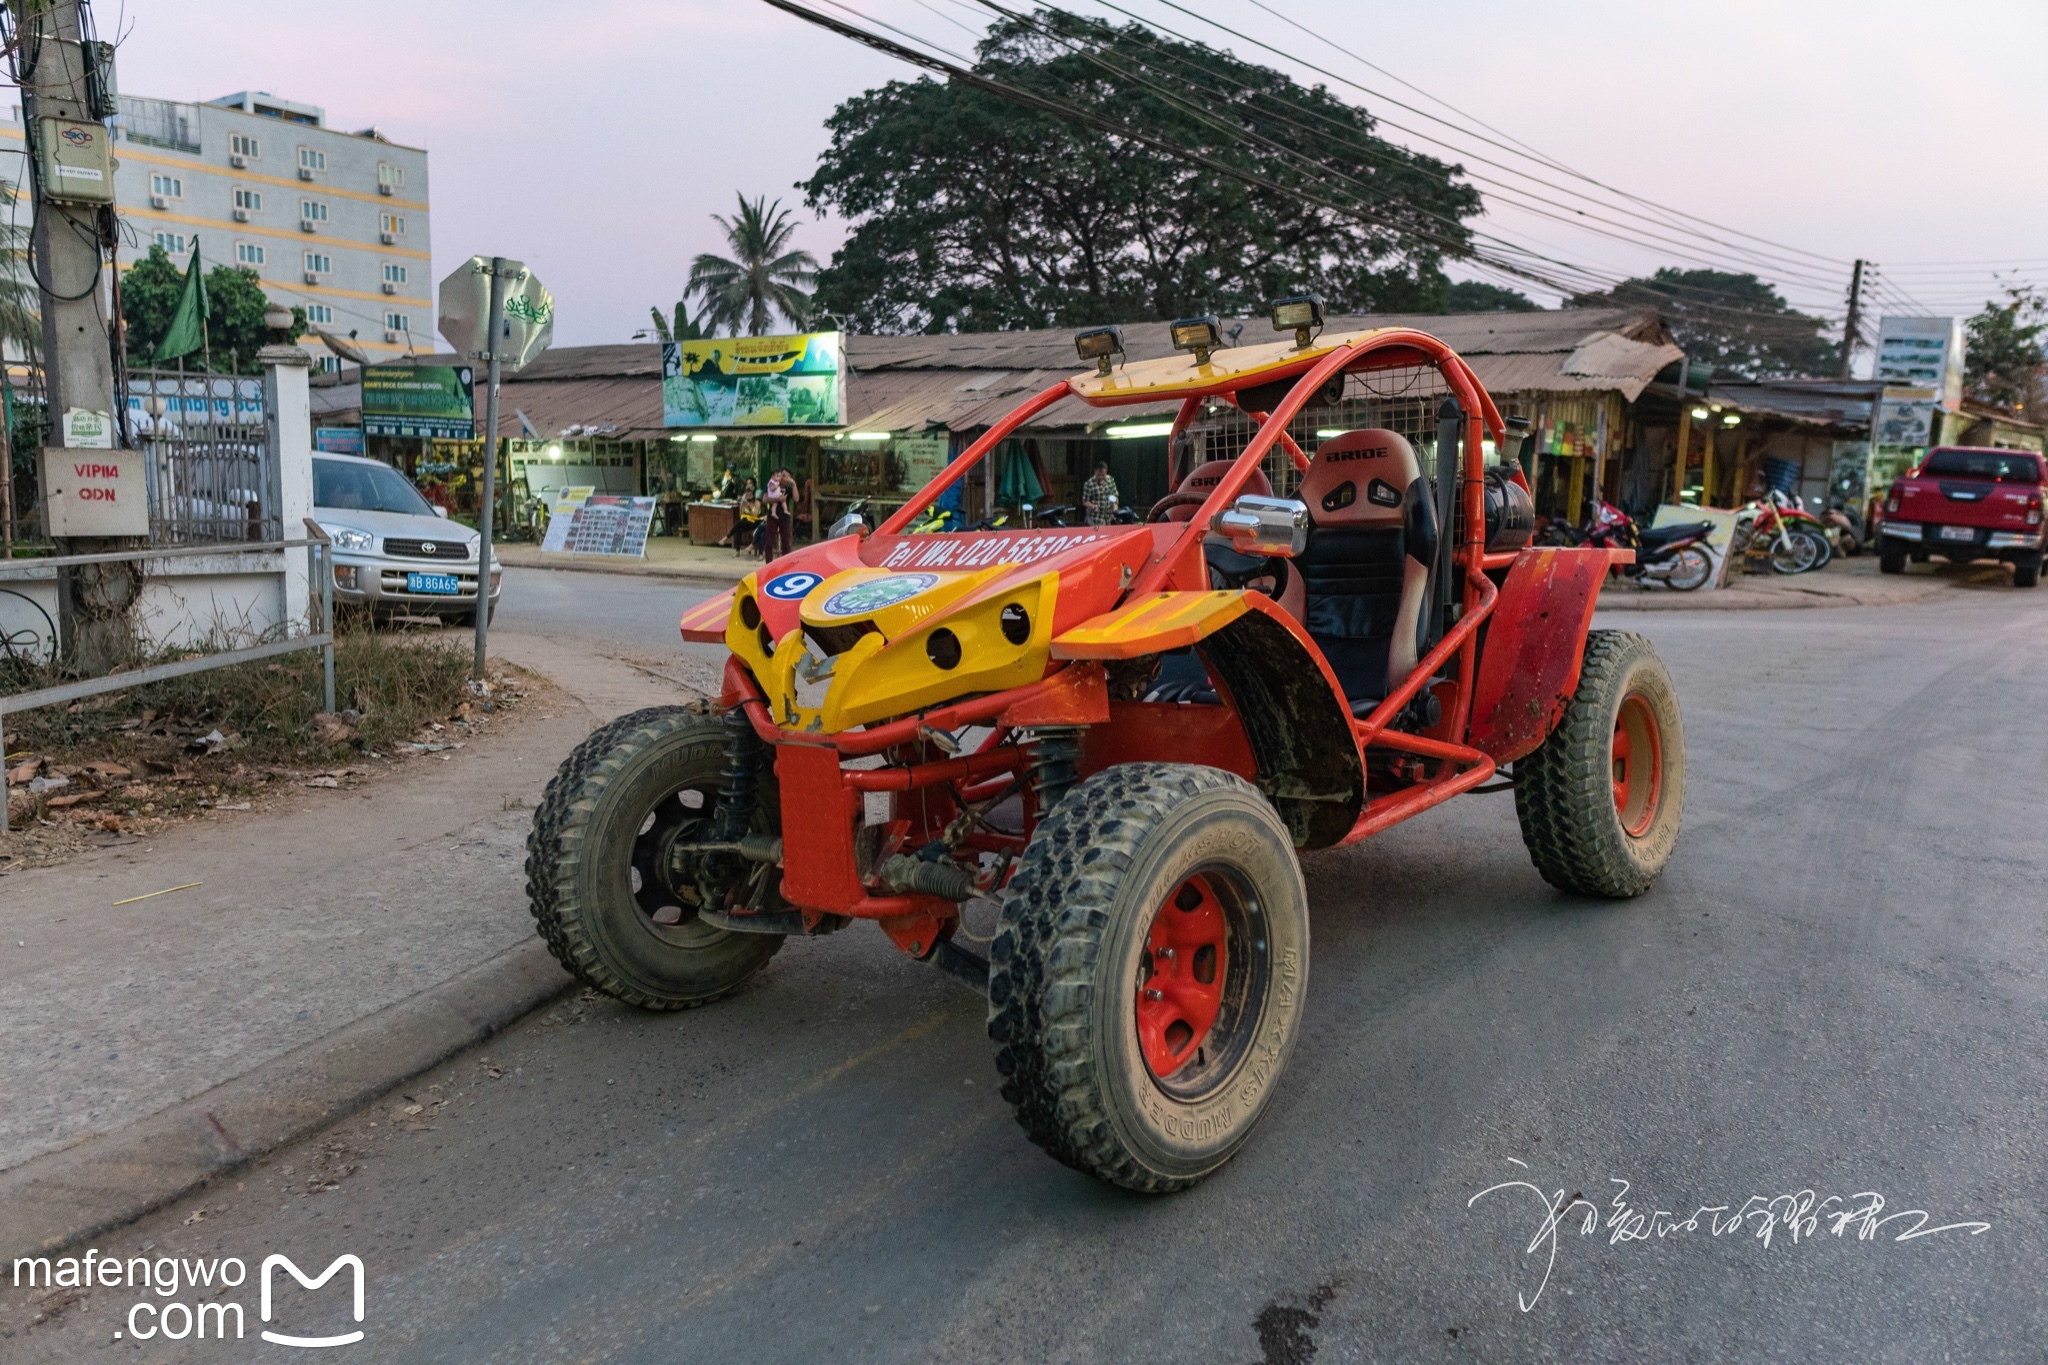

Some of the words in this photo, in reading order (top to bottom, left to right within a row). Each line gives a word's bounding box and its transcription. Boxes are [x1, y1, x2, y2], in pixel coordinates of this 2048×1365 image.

[397, 382, 421, 390] CLIMBING
[164, 393, 229, 417] limbing
[1326, 447, 1388, 463] BRIDE
[1190, 476, 1223, 487] BRI
[79, 487, 115, 501] ODN
[955, 538, 1010, 566] 020
[773, 575, 815, 595] 9
[850, 606, 871, 614] Tour
[873, 592, 913, 609] Service
[1240, 947, 1297, 1107] MAXXIS
[1138, 1078, 1232, 1140] MUDDER
